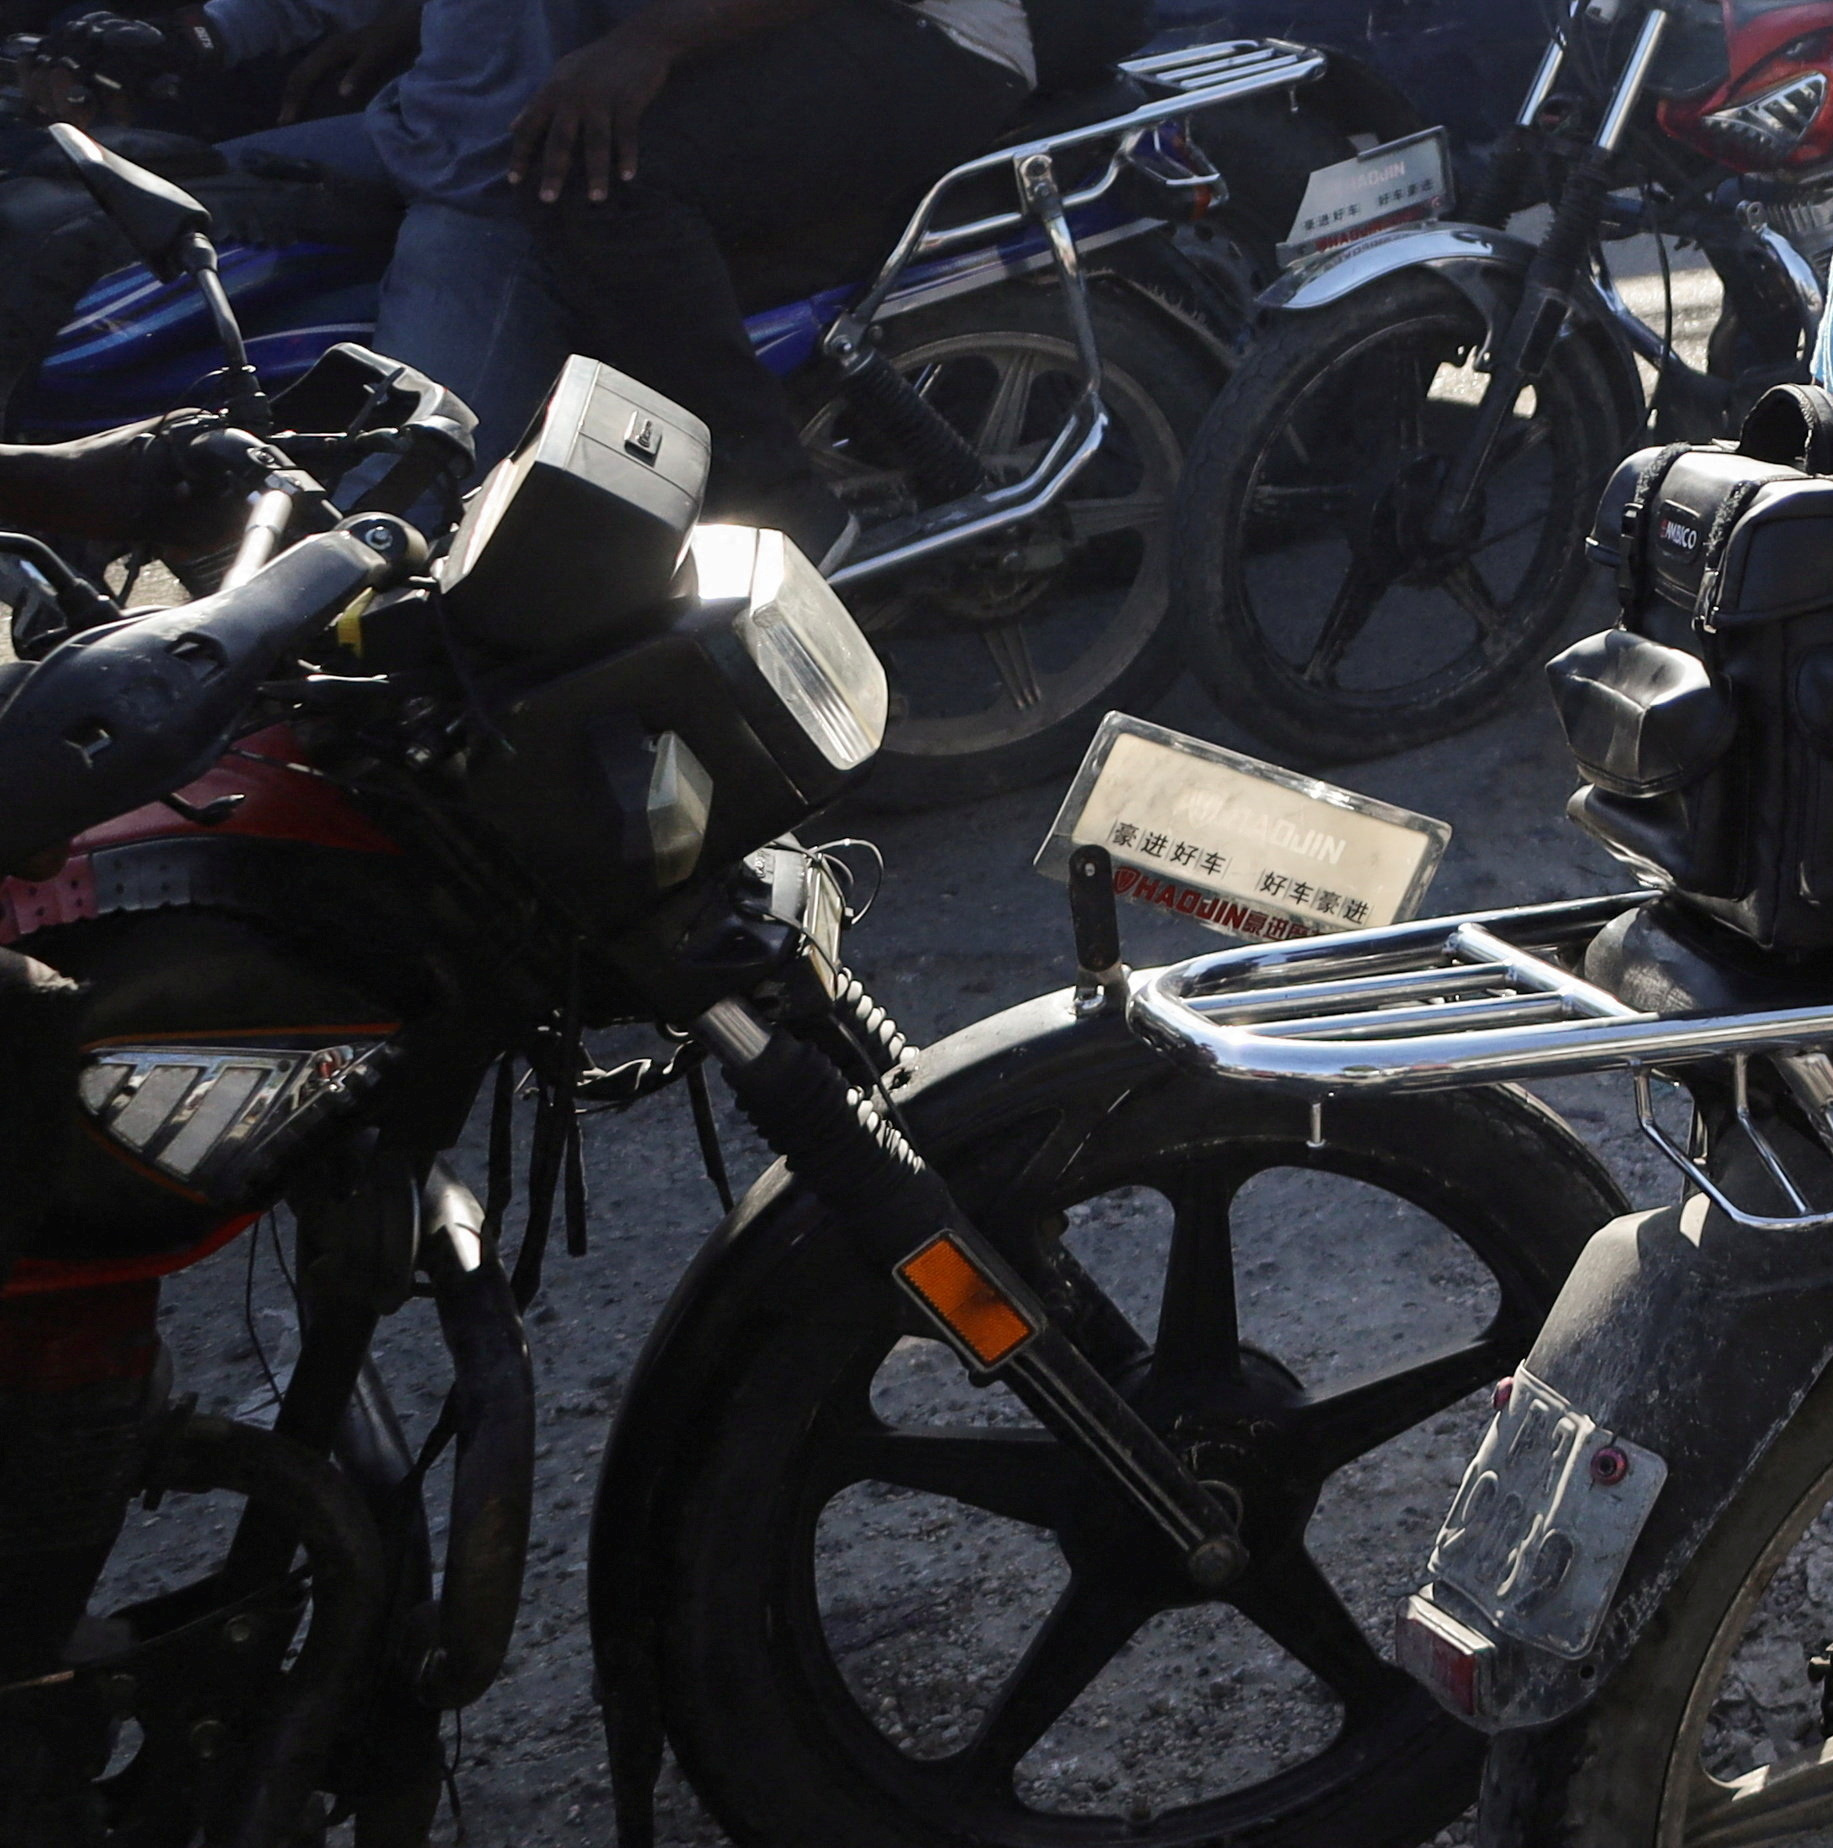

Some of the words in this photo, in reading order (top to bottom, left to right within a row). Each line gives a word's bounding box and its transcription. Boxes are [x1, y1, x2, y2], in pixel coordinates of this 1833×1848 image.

[1111, 821, 1227, 876] 豪进好车
[1259, 871, 1371, 926] 好车豪进
[1133, 871, 1249, 931] HAOJIN
